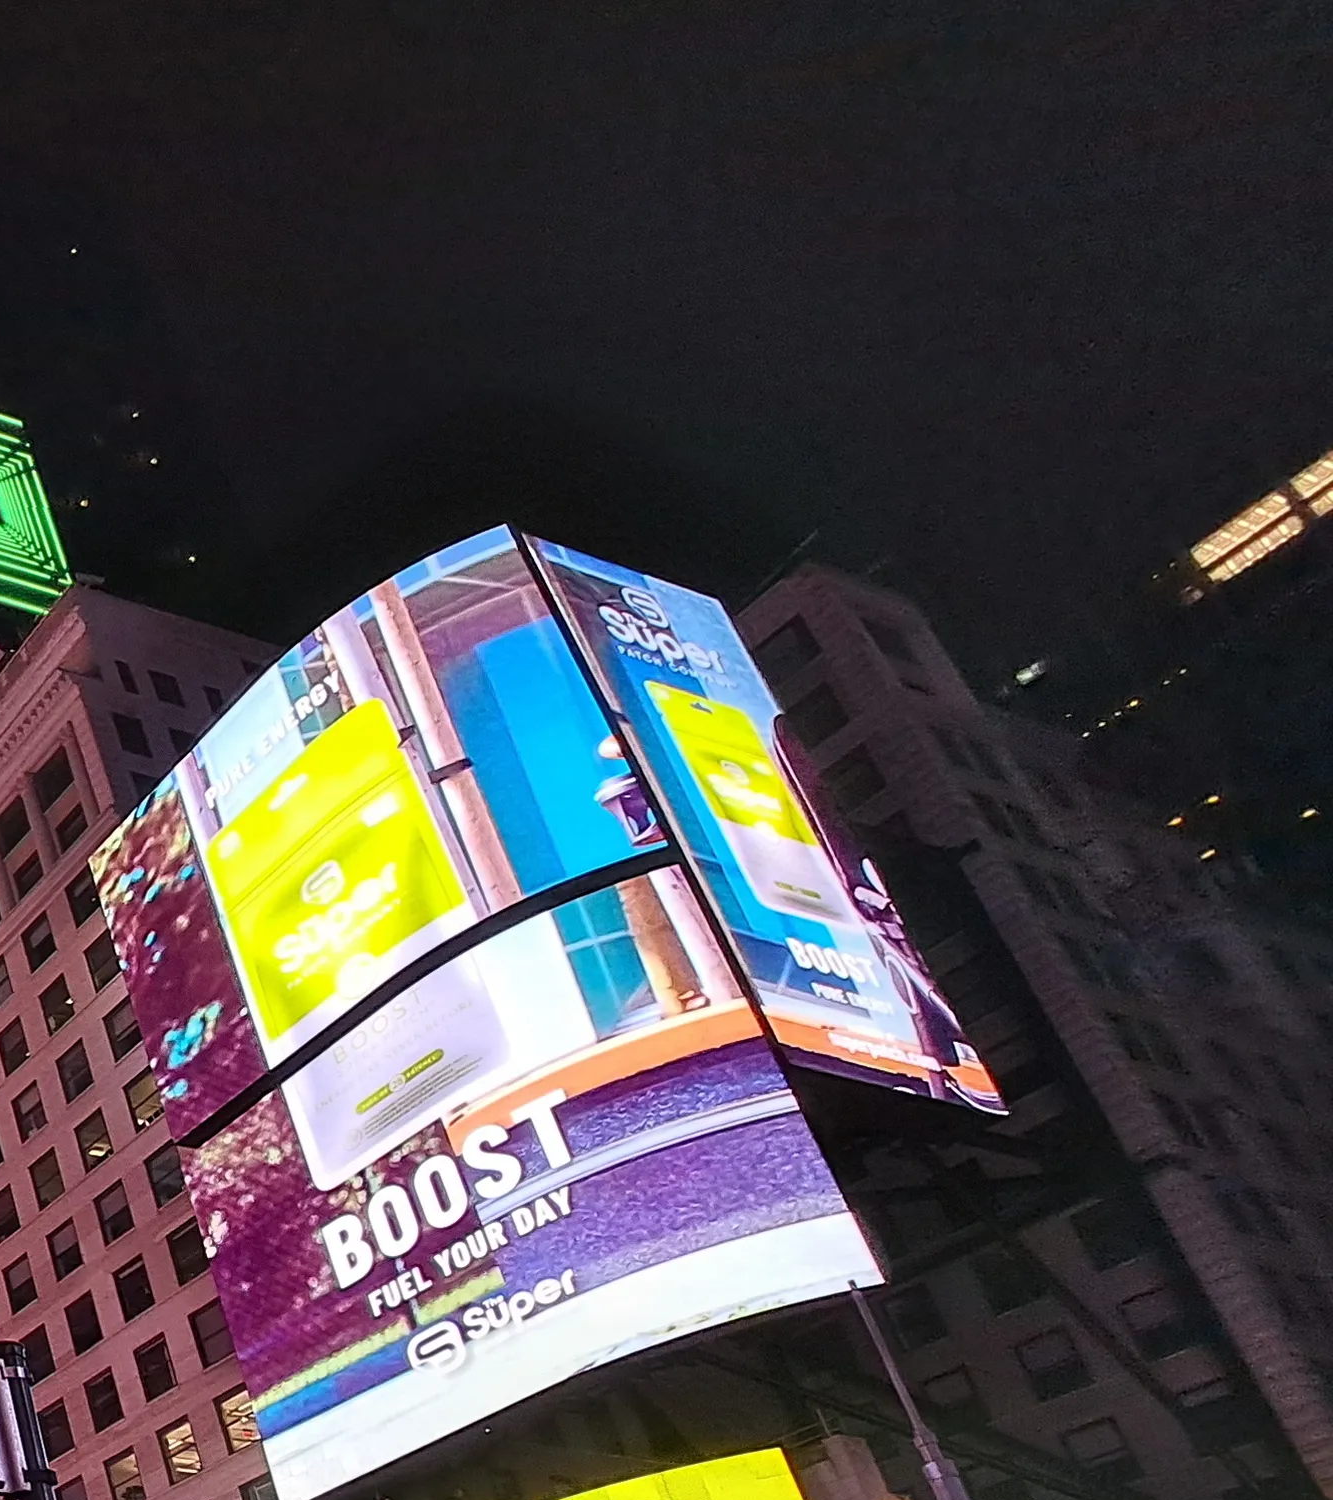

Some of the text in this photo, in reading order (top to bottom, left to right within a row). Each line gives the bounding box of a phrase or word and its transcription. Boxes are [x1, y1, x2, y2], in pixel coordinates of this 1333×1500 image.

[204, 669, 340, 810] PURE ENERGY
[785, 936, 880, 988] BOOST
[319, 1088, 577, 1292] BOOST
[367, 1186, 576, 1319] FUEL YOUR DAY
